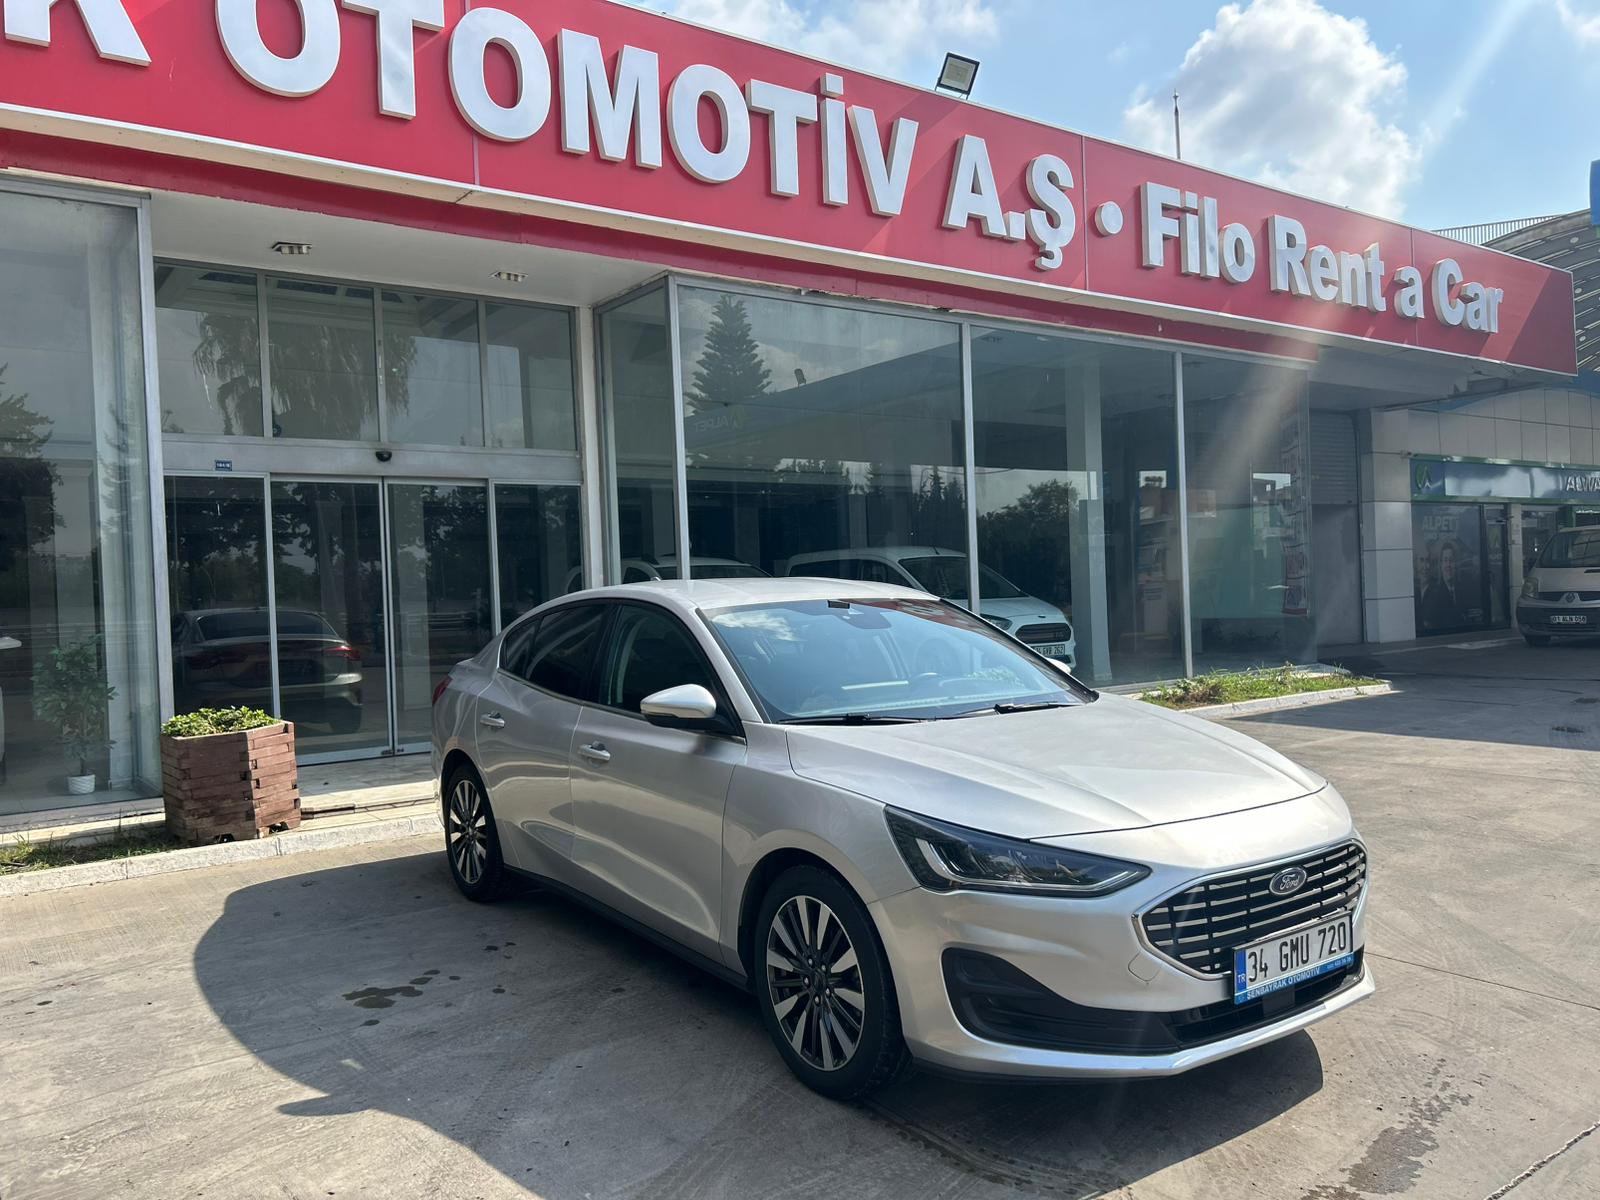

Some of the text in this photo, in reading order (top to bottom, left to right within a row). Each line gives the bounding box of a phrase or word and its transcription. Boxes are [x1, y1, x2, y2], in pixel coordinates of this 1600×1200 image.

[215, 0, 919, 217] OTOMOTİV
[942, 135, 1075, 271] A.Ş
[1139, 182, 1256, 284] Filo
[1267, 214, 1387, 313] Rent
[1394, 265, 1426, 320] a
[1432, 257, 1505, 334] Car
[1279, 873, 1300, 891] Ford
[1237, 973, 1246, 984] TR
[1248, 949, 1268, 982] 34
[1279, 934, 1310, 972] GMU
[1317, 921, 1347, 960] 720
